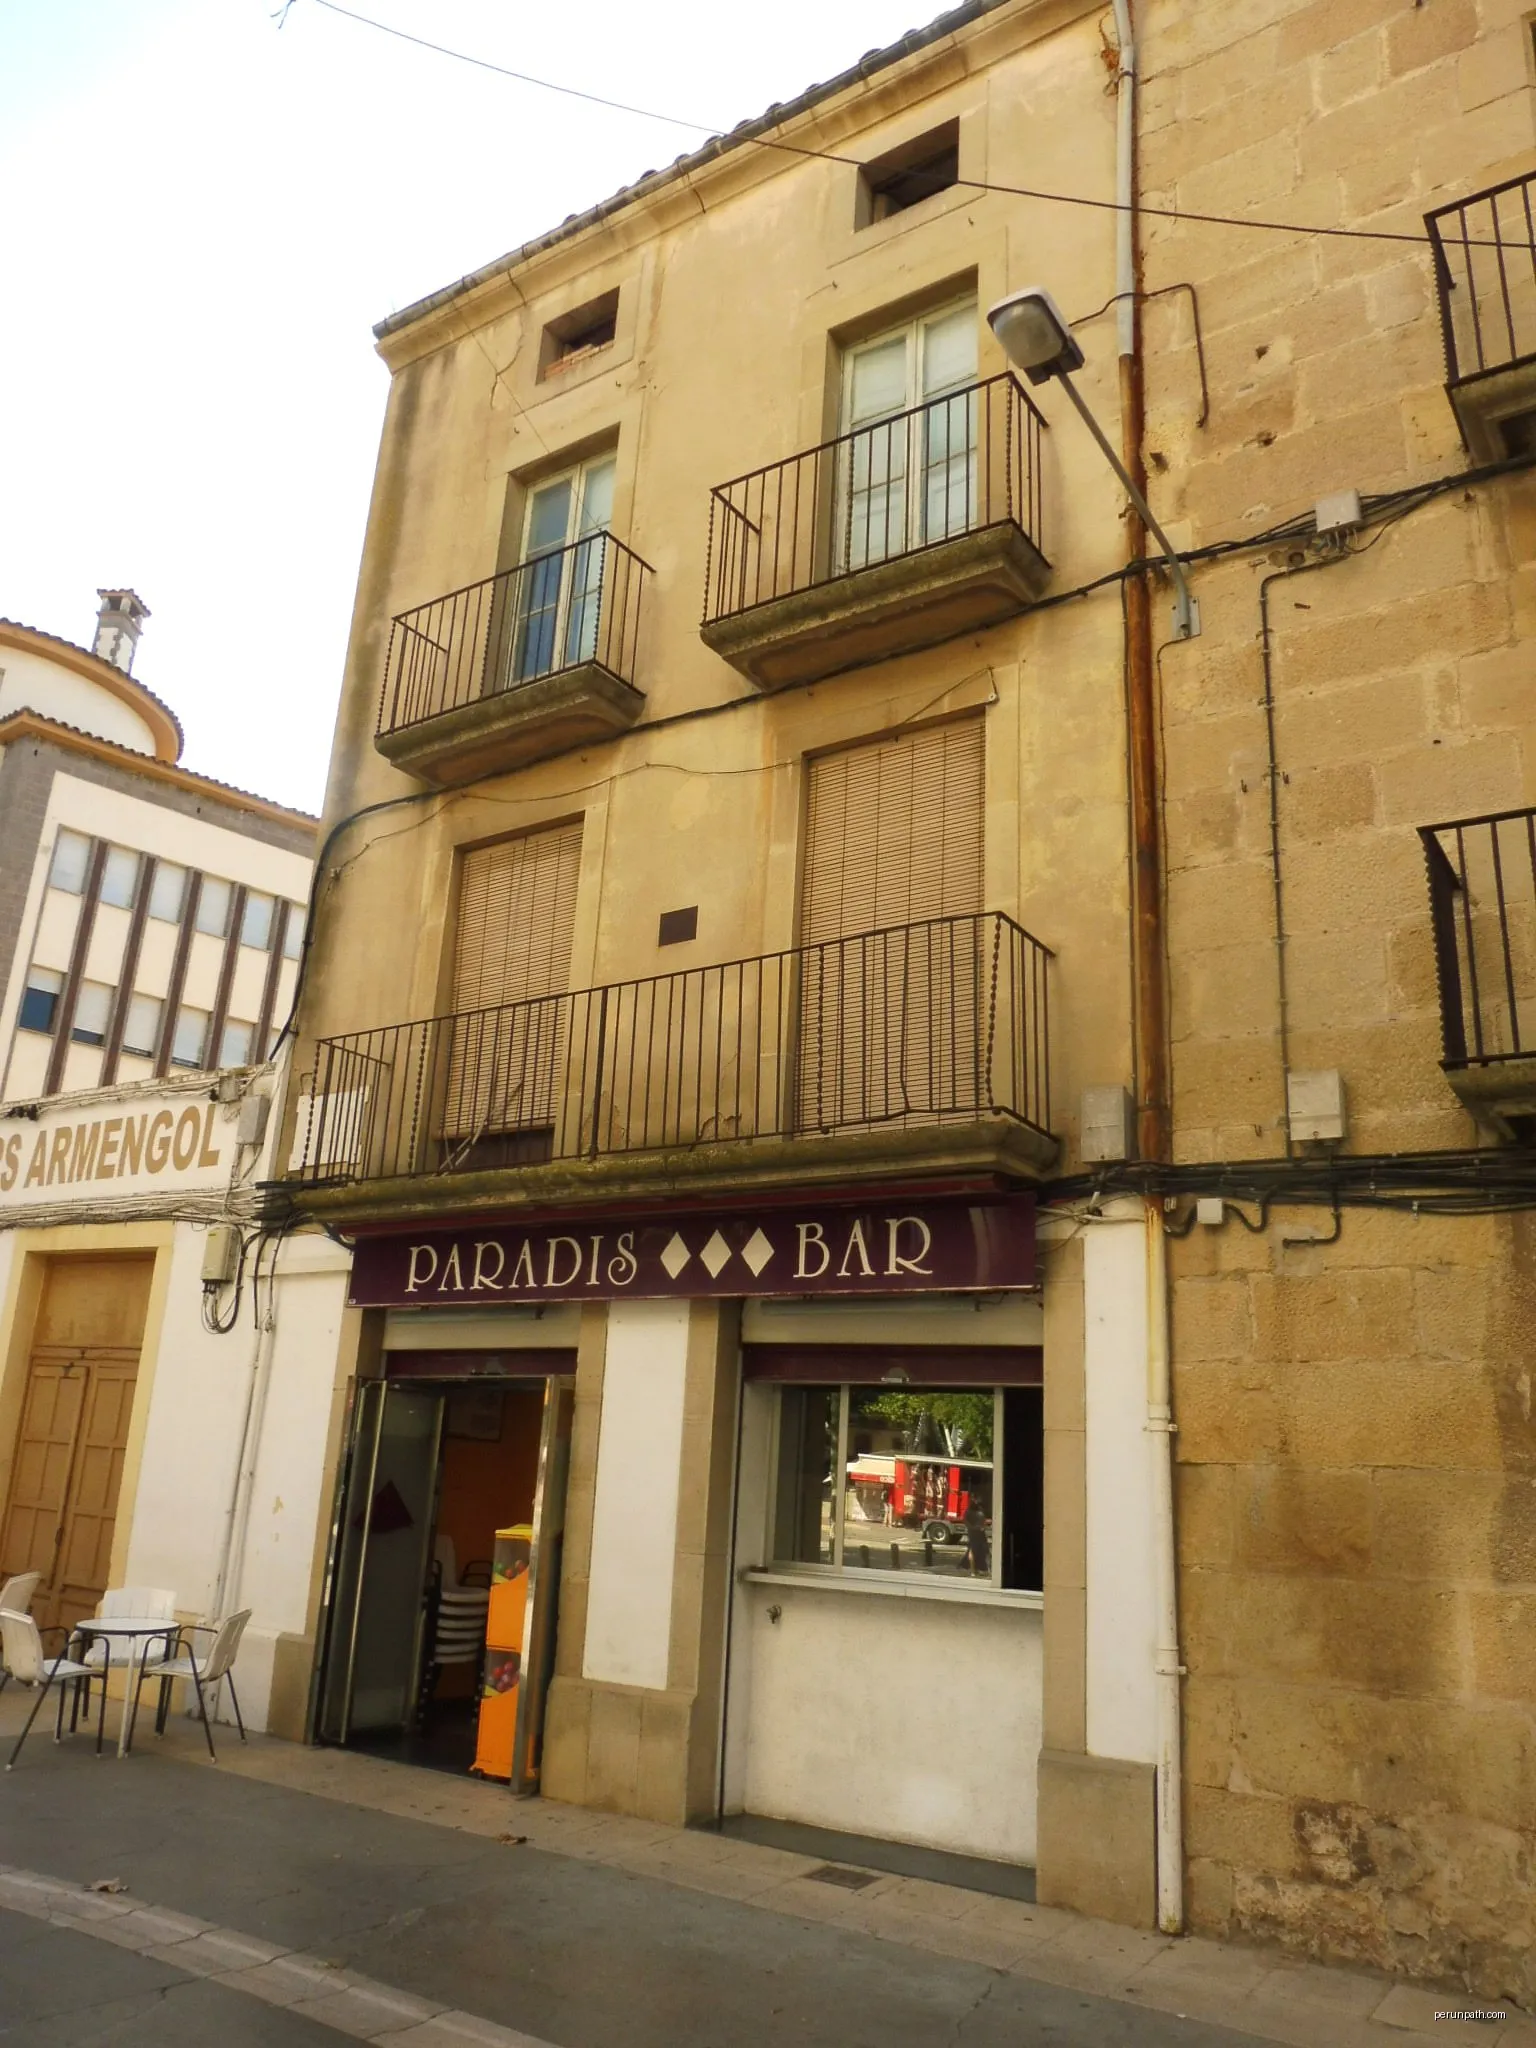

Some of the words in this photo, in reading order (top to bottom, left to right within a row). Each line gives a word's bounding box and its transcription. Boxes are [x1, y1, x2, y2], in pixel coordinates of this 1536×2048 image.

[0, 1133, 22, 1192] S
[23, 1104, 221, 1188] ARMENGOL
[404, 1231, 638, 1293] PARADIS
[793, 1216, 934, 1278] BAR
